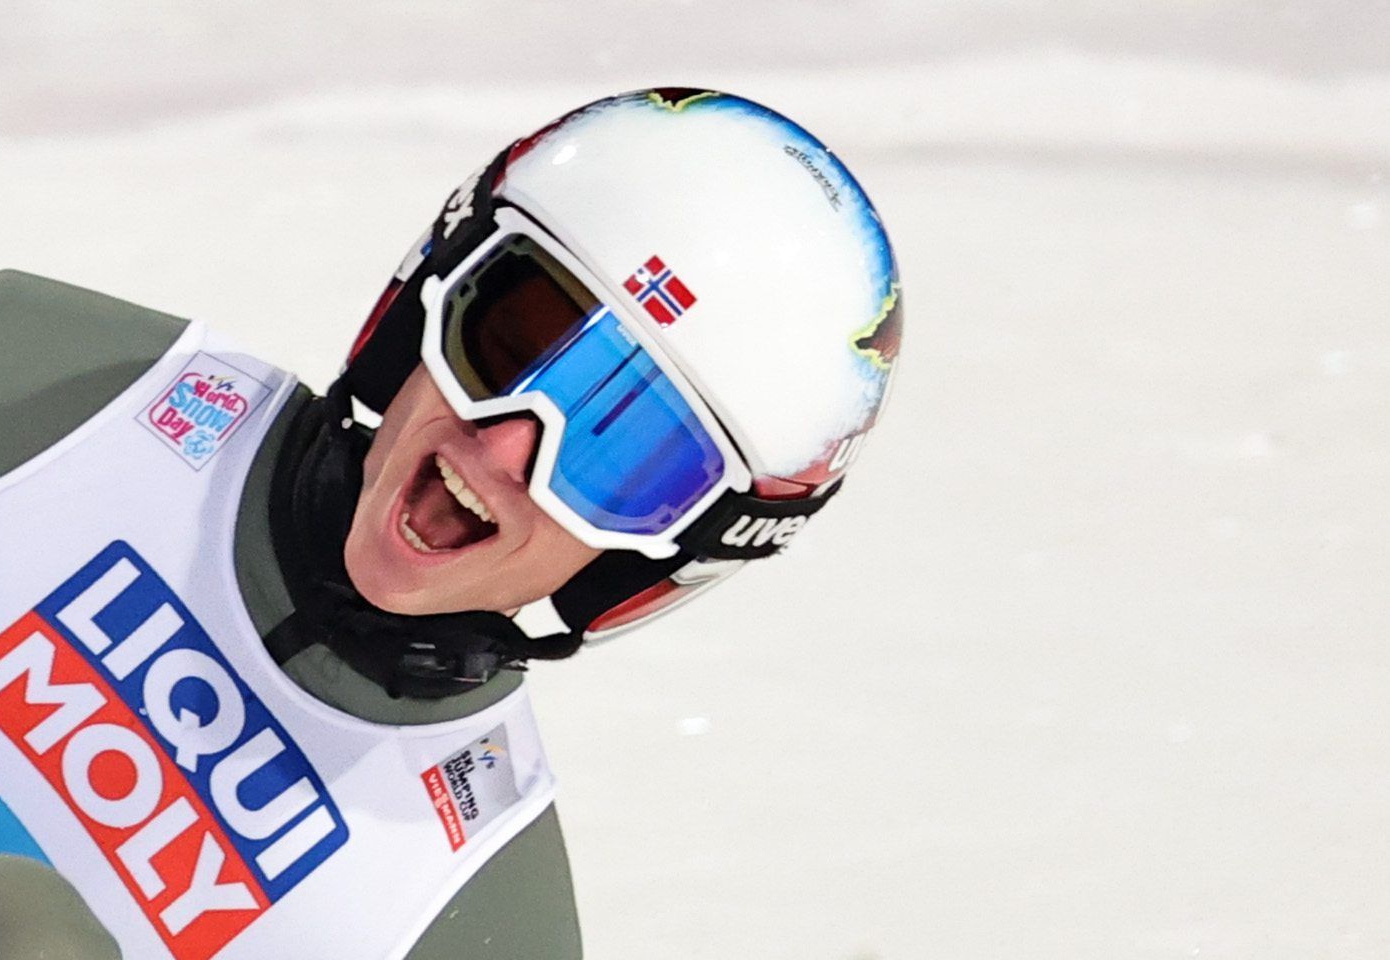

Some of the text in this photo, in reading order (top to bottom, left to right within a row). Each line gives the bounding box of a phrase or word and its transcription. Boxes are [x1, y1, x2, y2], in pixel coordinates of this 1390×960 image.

[157, 406, 195, 439] Day
[721, 515, 807, 547] uve
[55, 556, 336, 882] LIQUI
[461, 750, 475, 774] SKI
[443, 761, 462, 800] WORLD
[451, 754, 479, 820] JUMPING
